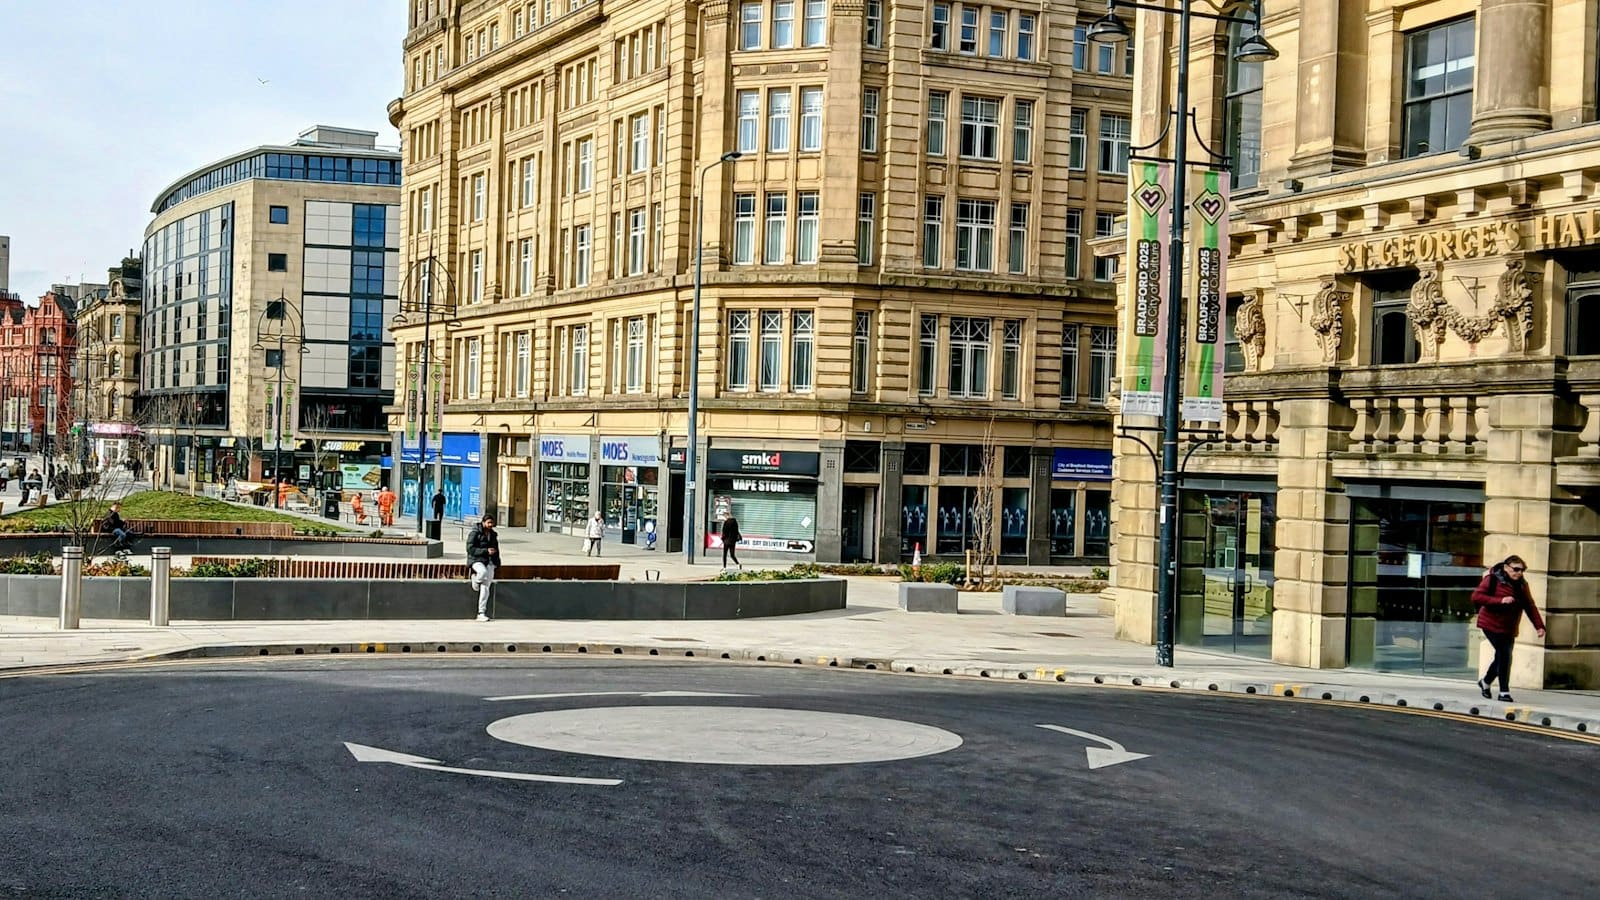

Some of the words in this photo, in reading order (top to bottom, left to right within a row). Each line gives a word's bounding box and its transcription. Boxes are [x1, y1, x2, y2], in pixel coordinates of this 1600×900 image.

[1139, 242, 1149, 269] 2025
[1337, 243, 1375, 270] ST.
[1379, 221, 1521, 266] GEORGE'S
[1149, 242, 1159, 280] Culture
[1200, 250, 1210, 277] 2025
[1209, 250, 1219, 288] Culture
[1149, 281, 1159, 294] of
[1209, 289, 1218, 301] of
[1137, 271, 1149, 334] BRADFORD
[1148, 296, 1160, 317] City
[1198, 279, 1209, 341] BRADFORD
[1208, 302, 1219, 324] City
[1147, 320, 1157, 335] UK
[1208, 326, 1217, 342] UK
[323, 441, 365, 451] SUBWAY
[541, 440, 564, 457] MOES
[602, 442, 629, 461] MOES
[741, 452, 781, 466] smkd
[732, 479, 757, 491] VAPE
[758, 480, 790, 493] STORE
